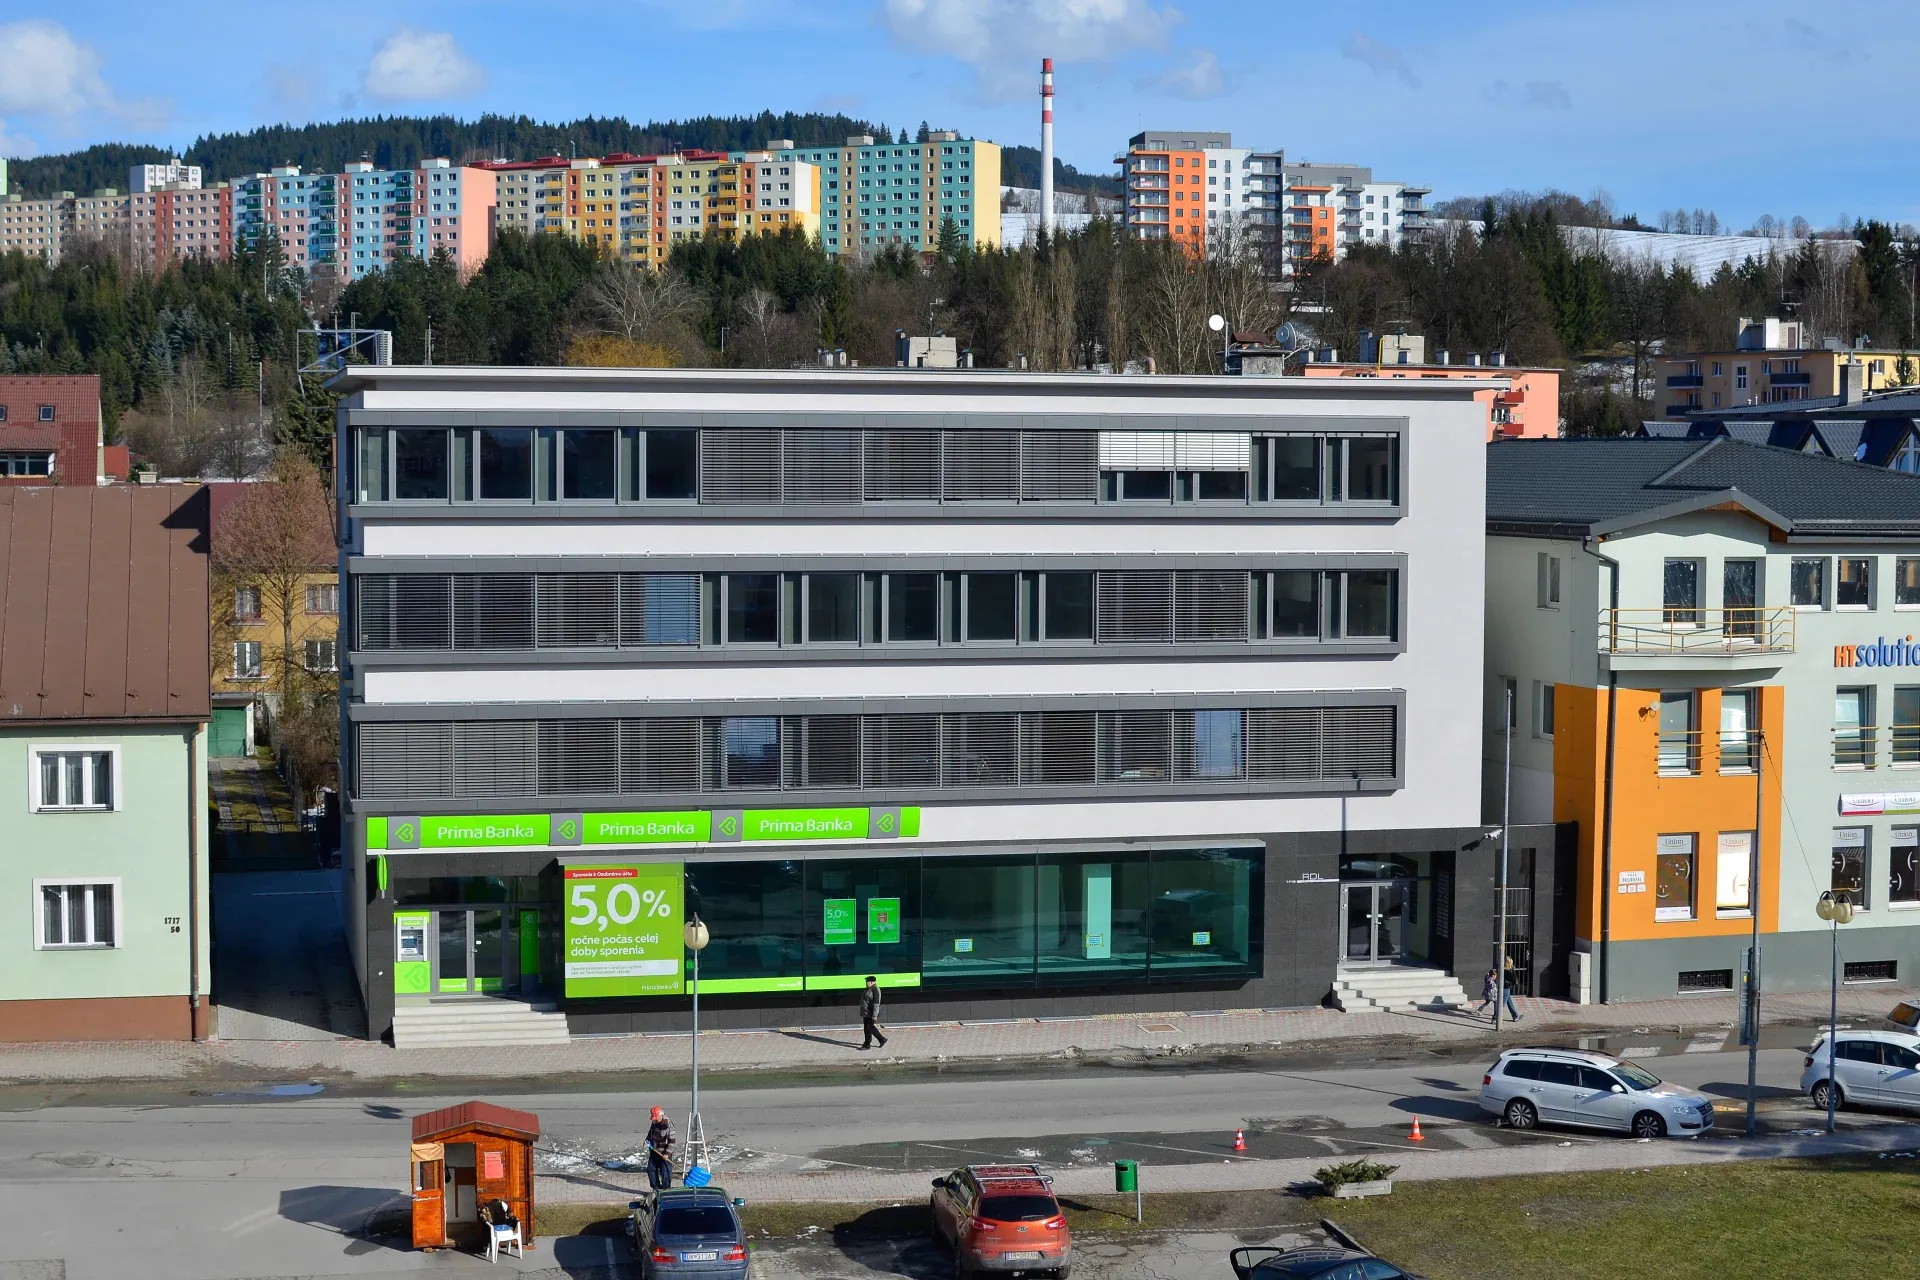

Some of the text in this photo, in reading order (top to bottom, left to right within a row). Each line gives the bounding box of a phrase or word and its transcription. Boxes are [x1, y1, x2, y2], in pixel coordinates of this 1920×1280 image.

[437, 825, 534, 839] Prima Banka
[600, 821, 694, 836] Prima Banka
[760, 819, 853, 833] Prima Banka
[570, 883, 671, 932] 5,0%
[164, 916, 180, 924] 1717
[826, 909, 849, 920] 5,0%
[170, 926, 180, 934] 50
[571, 933, 659, 946] ročne počas celej
[571, 945, 645, 958] doby sporenia
